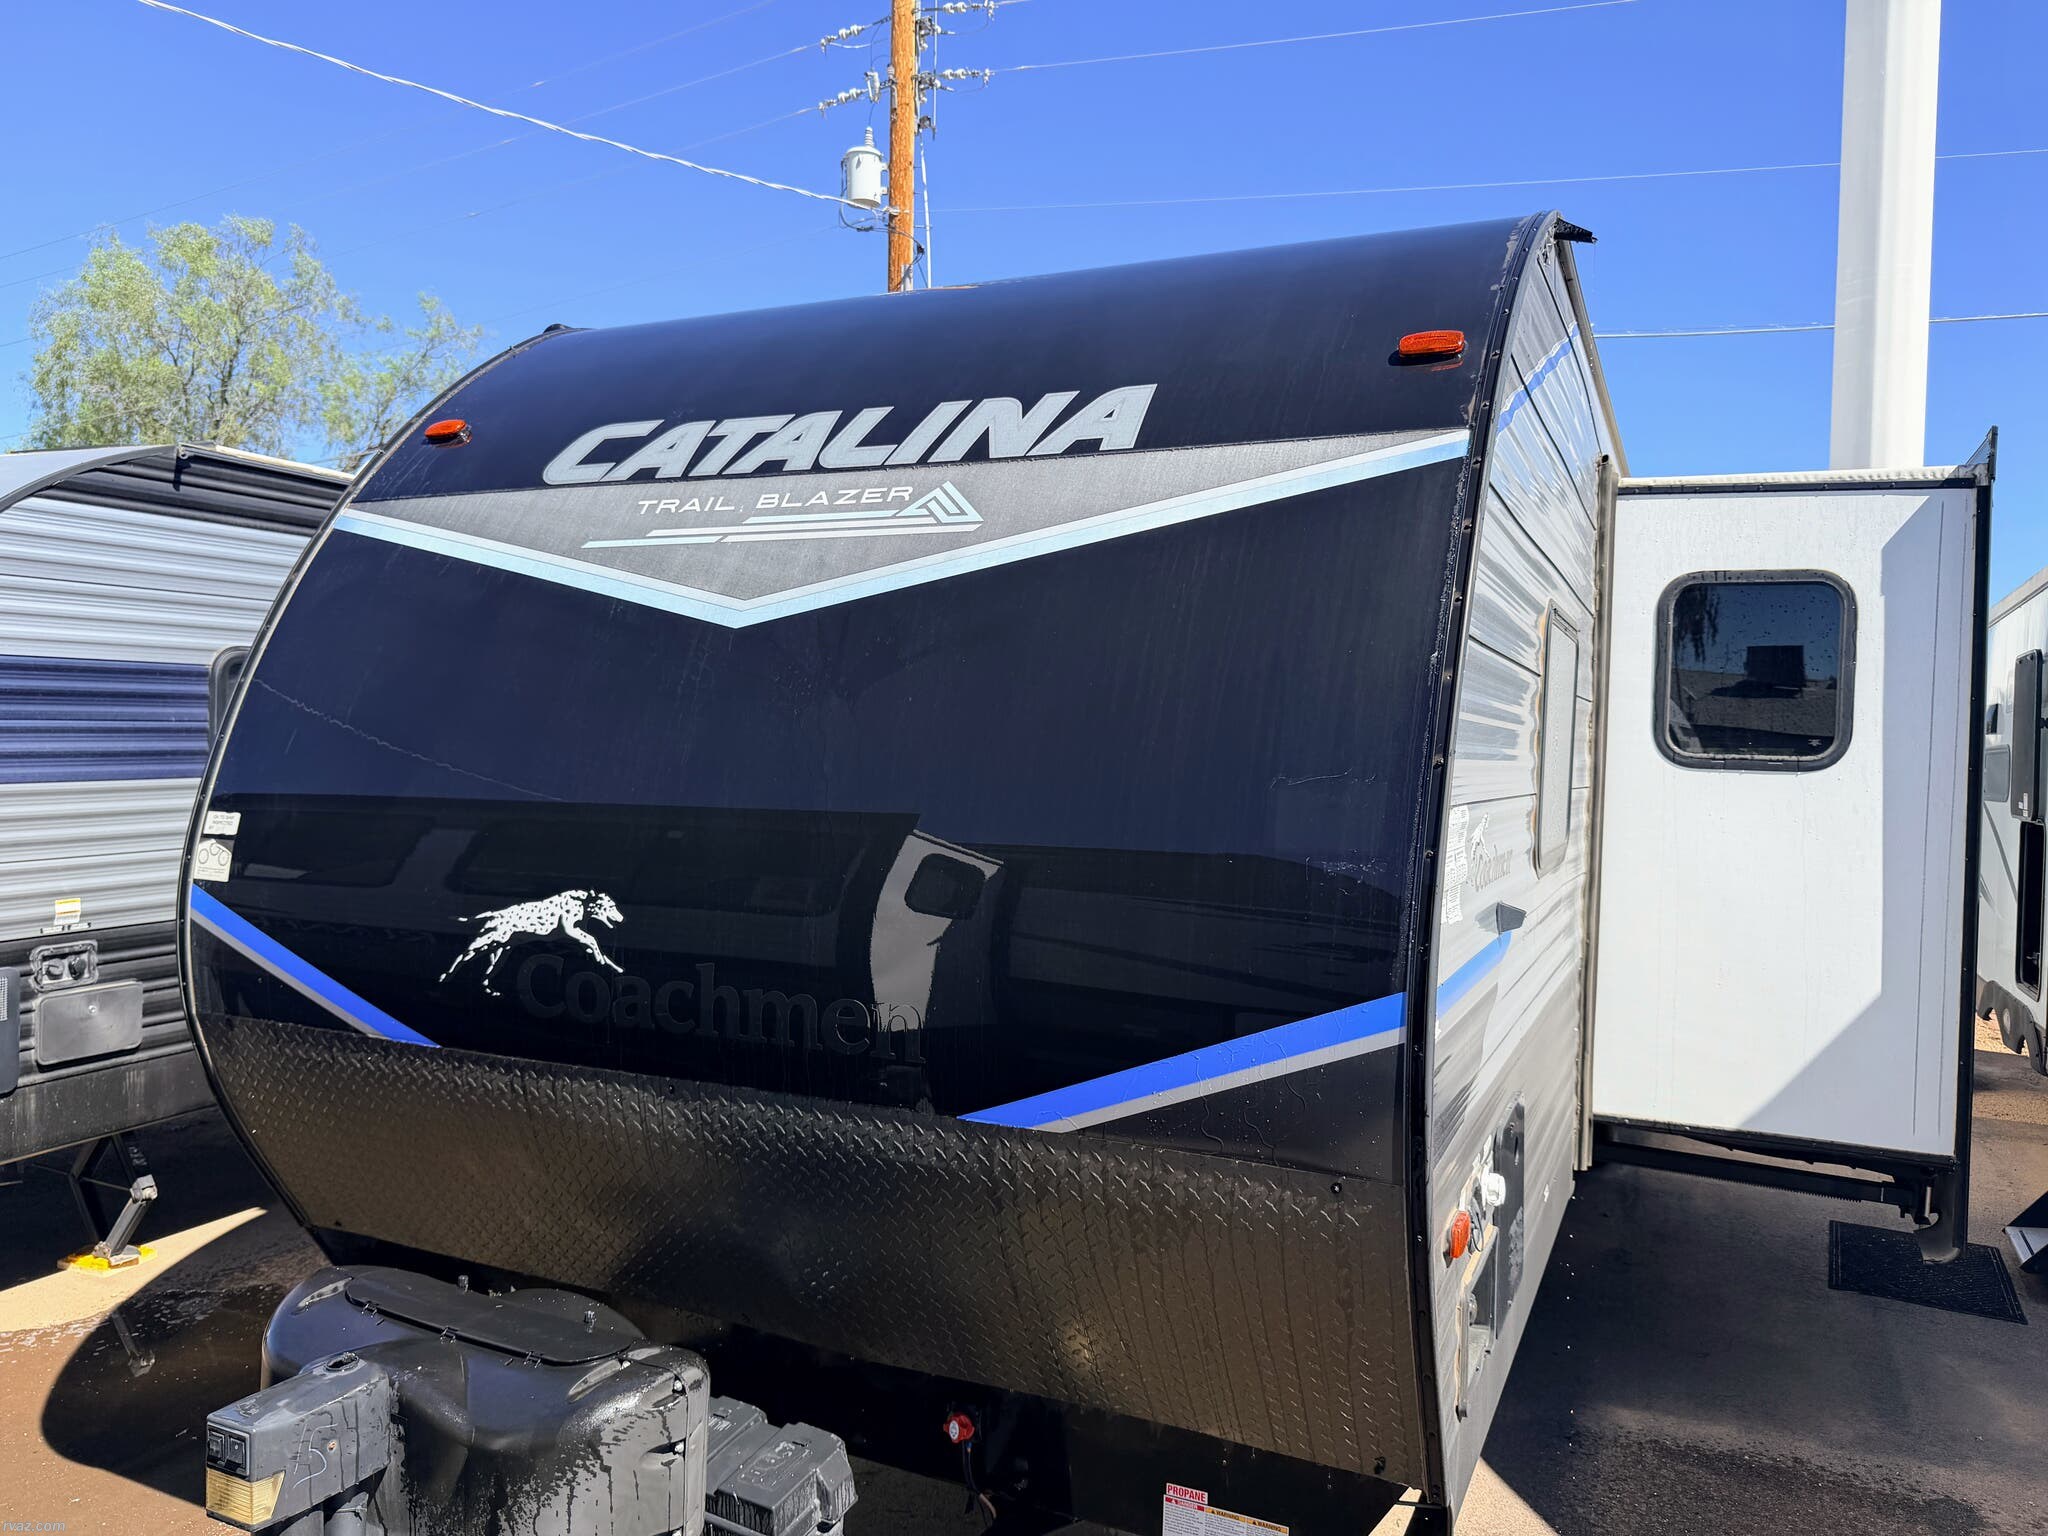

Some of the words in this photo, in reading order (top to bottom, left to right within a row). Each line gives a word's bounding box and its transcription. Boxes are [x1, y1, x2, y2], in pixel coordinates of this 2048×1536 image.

[542, 384, 1157, 486] CATALINA
[638, 495, 736, 515] TRAIL
[755, 486, 914, 510] BLAZER
[515, 953, 926, 1065] Coachmen
[1167, 1484, 1206, 1502] PROPANE
